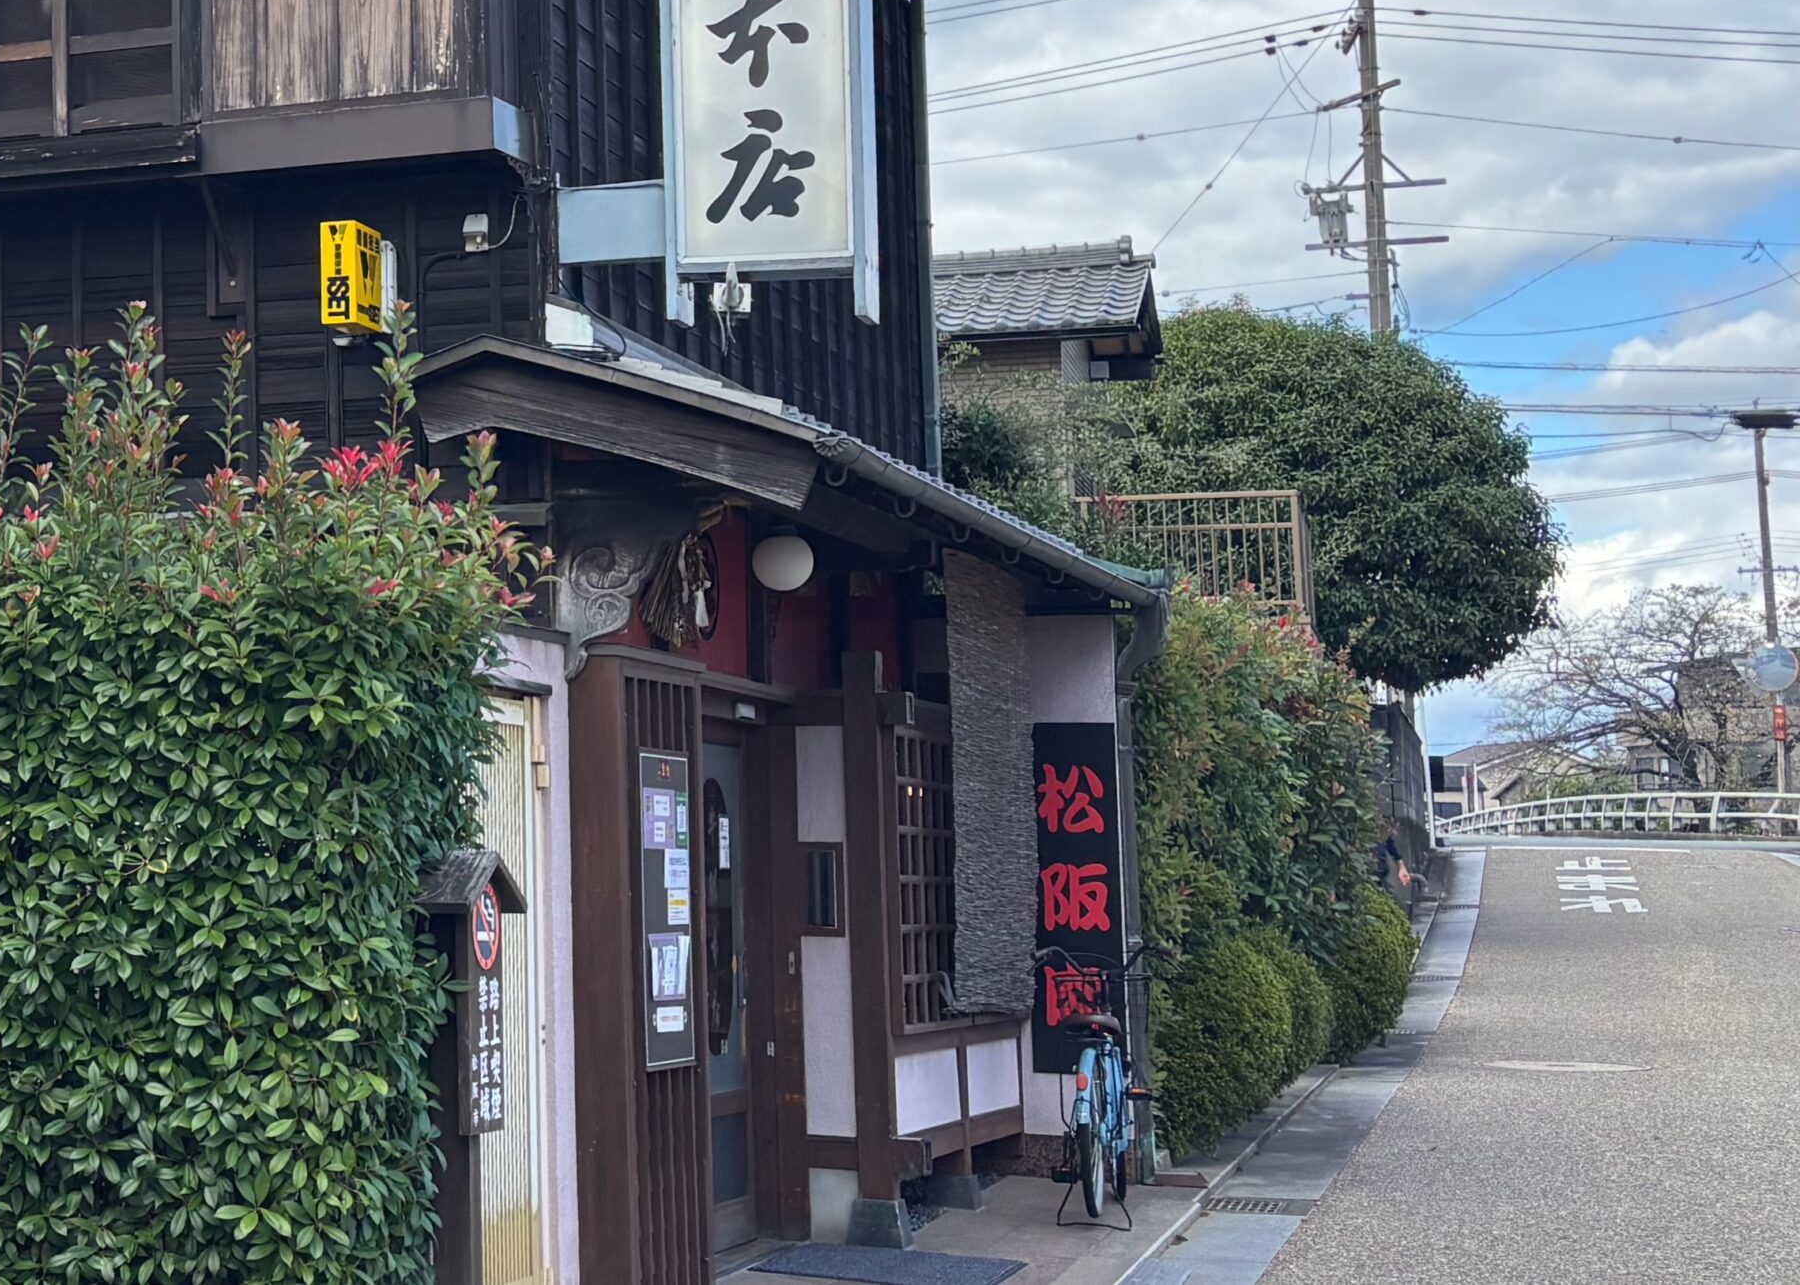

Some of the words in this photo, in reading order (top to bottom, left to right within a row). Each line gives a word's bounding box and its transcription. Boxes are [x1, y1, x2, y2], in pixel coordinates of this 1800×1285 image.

[327, 276, 350, 320] ISET
[1554, 856, 1649, 913] 止まれ
